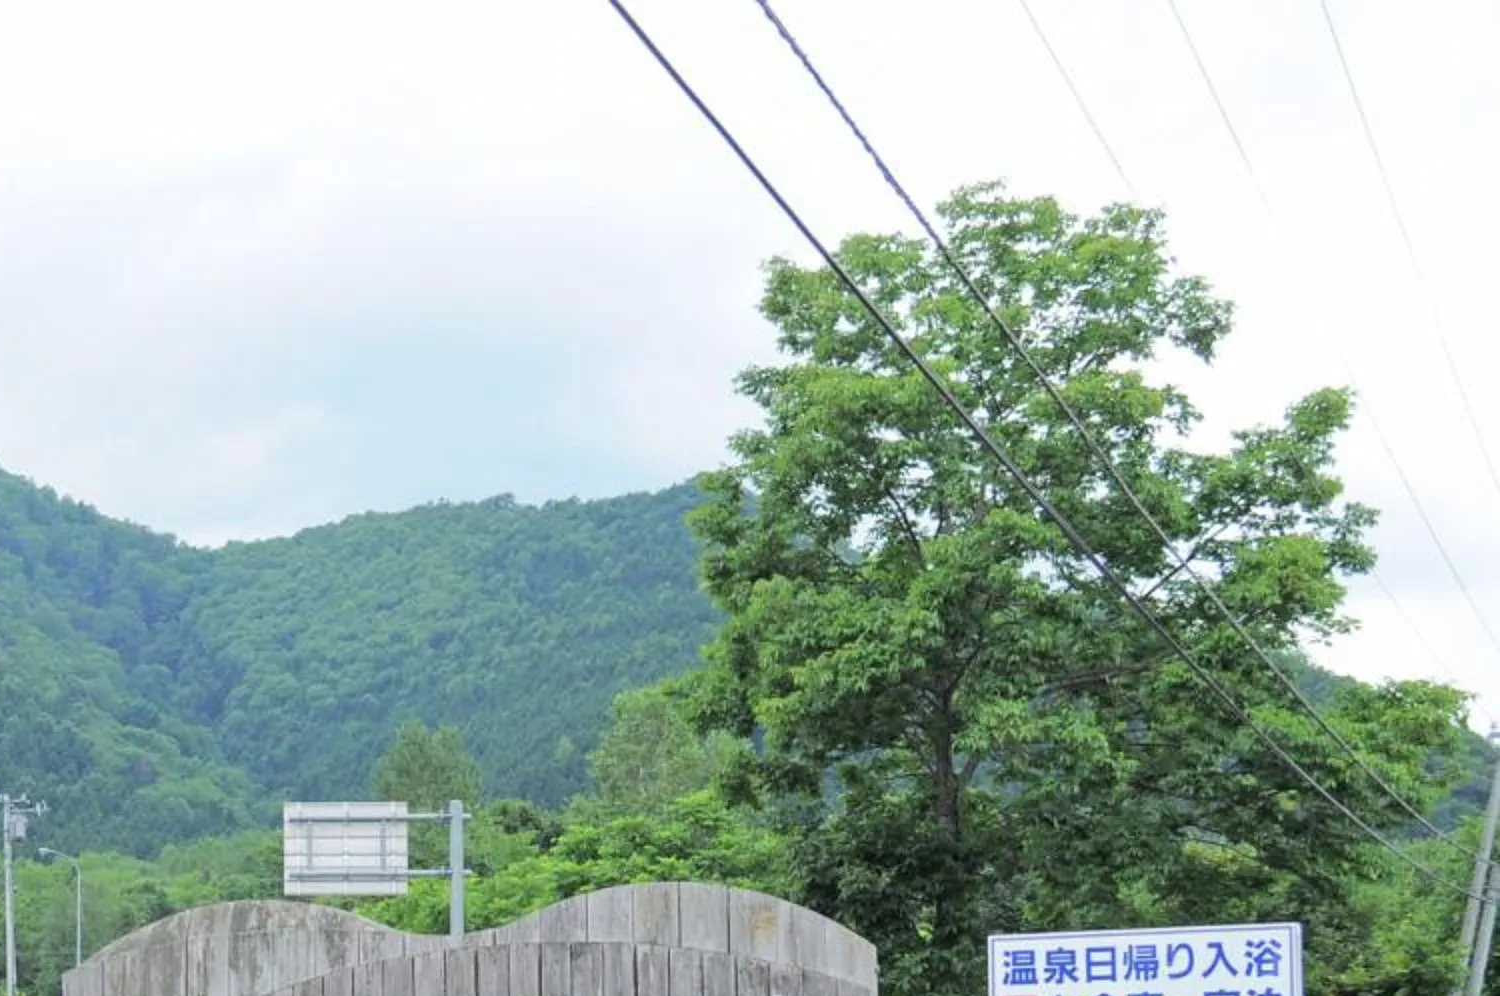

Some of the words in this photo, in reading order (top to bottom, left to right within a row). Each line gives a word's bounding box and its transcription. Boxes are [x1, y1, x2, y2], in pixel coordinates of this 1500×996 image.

[1002, 939, 1283, 985] 温泉日帰り入浴
